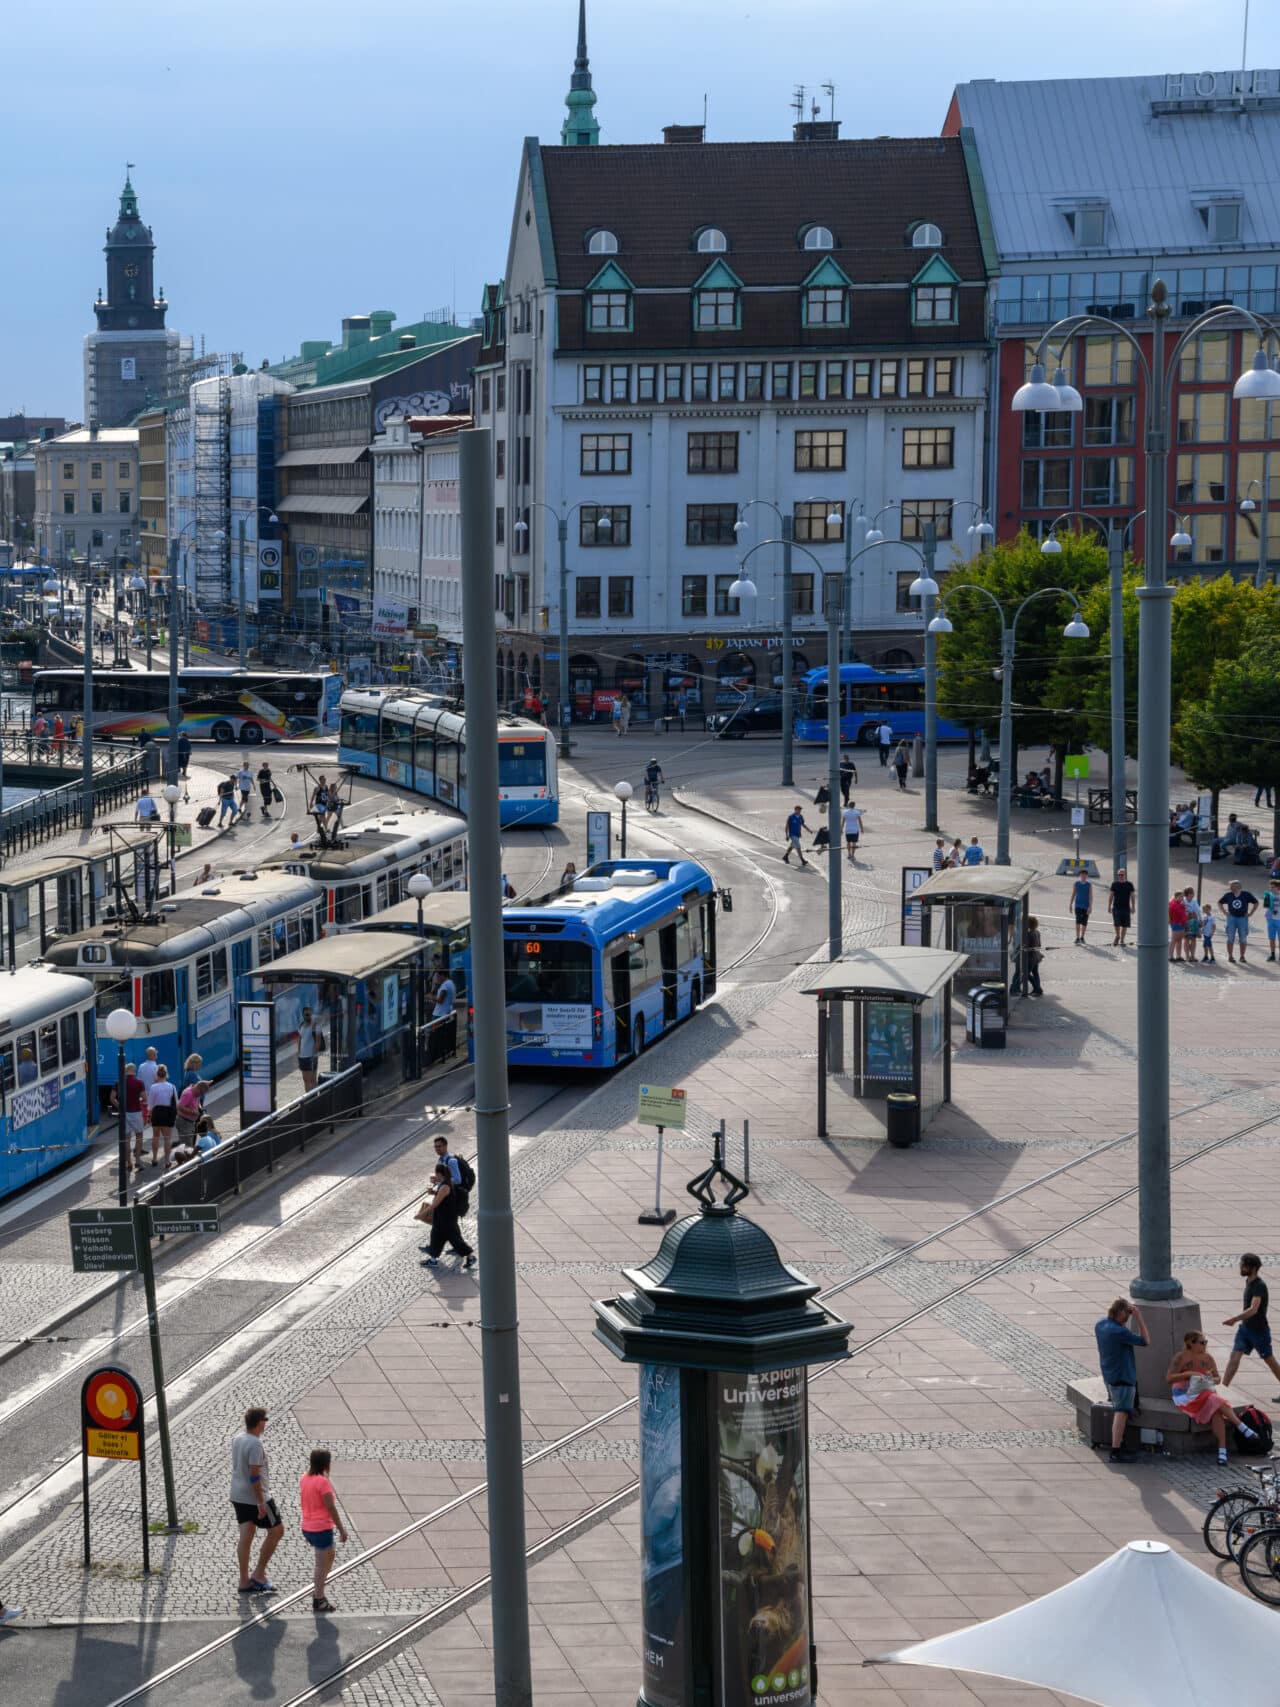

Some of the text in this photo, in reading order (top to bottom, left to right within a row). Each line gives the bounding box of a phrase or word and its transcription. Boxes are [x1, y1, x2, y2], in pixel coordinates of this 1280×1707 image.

[1164, 71, 1280, 97] HOTE
[86, 947, 101, 960] 11
[526, 942, 540, 953] 60
[251, 1010, 261, 1031] C
[80, 1227, 112, 1235] Liseberg
